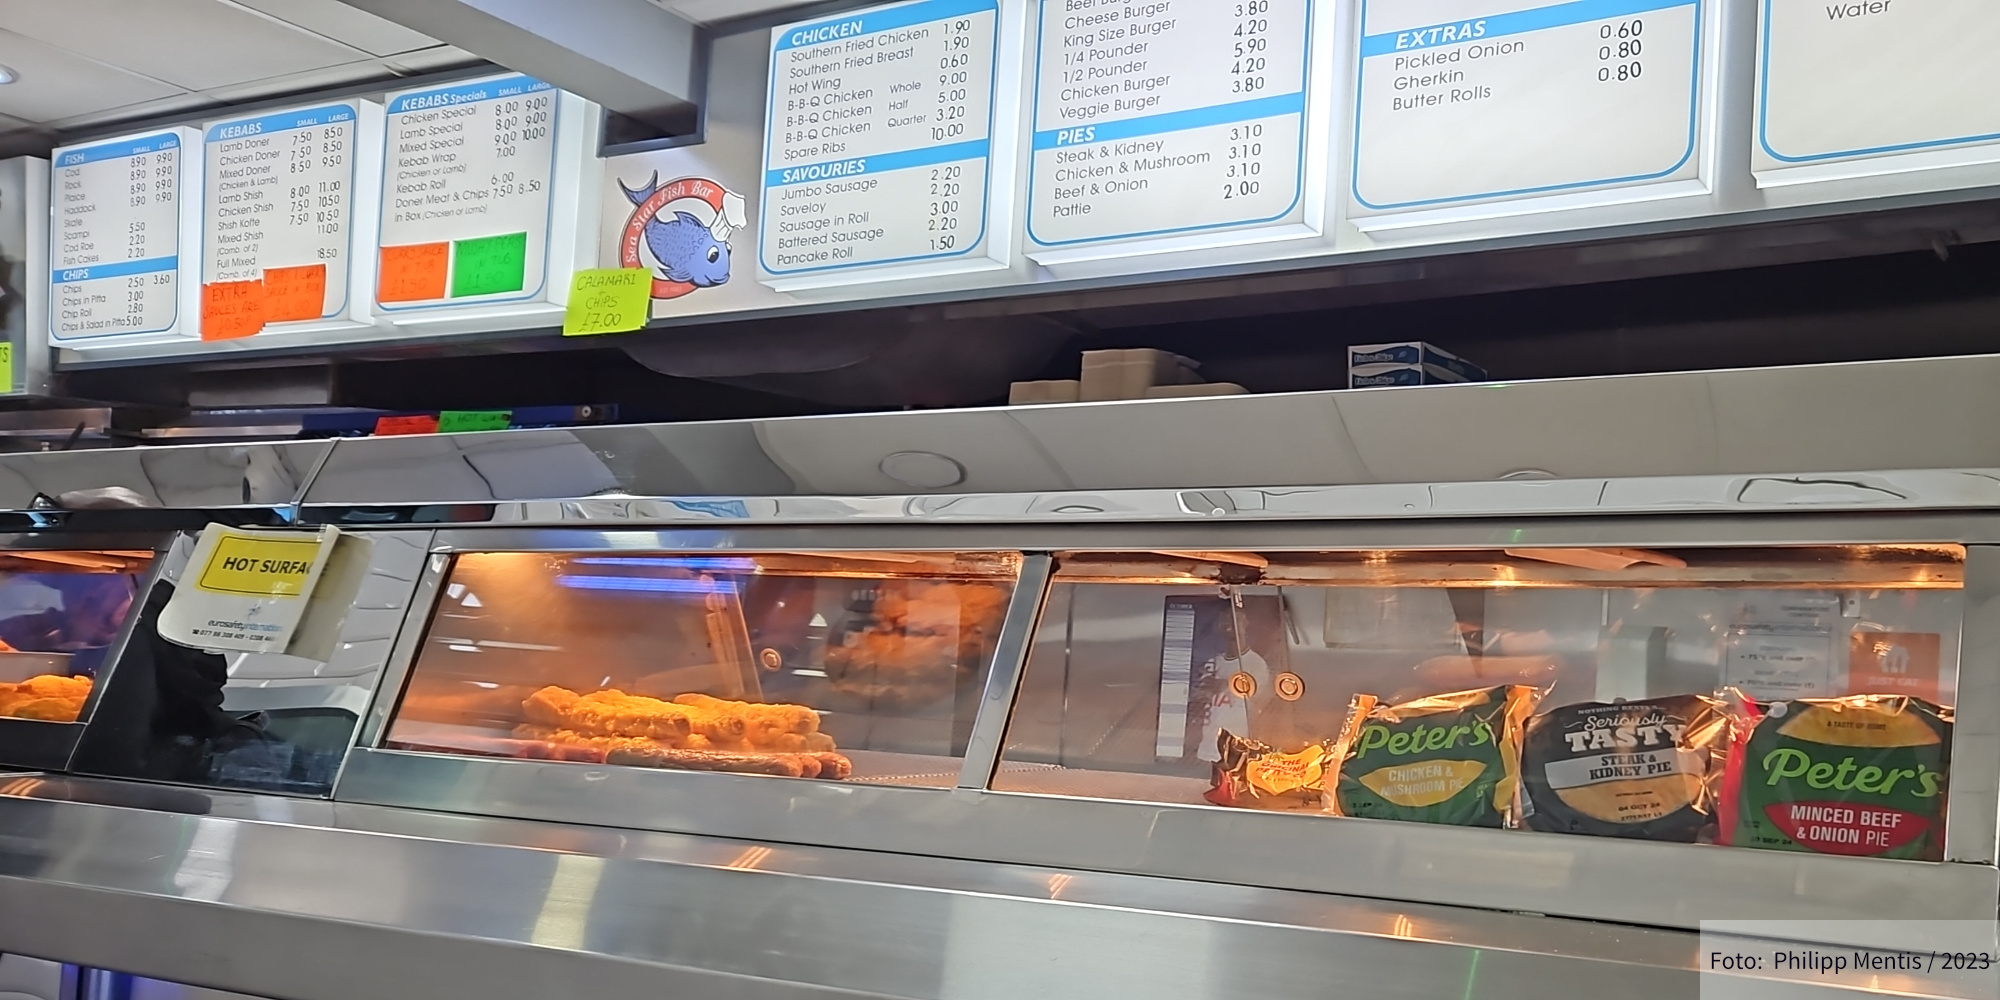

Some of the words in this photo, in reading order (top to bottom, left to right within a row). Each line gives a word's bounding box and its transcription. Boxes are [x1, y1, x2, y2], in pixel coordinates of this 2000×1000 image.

[1065, 11, 1119, 29] Cheese
[1124, 2, 1170, 18] Burger
[1825, 0, 1891, 20] Water
[791, 20, 863, 46] CHICKEN
[1064, 34, 1094, 47] King
[1099, 28, 1125, 42] Size
[1130, 18, 1177, 35] Burger
[1234, 0, 1268, 18] 3.80
[1395, 20, 1486, 50] EXTRAS
[790, 43, 842, 62] Southern
[845, 37, 874, 53] Fried
[878, 27, 929, 47] Chicken
[944, 19, 971, 34] 1.90
[1064, 51, 1084, 66] 1/4
[1089, 42, 1149, 62] Pounder
[1233, 19, 1268, 37] 4.20
[1394, 48, 1460, 71] Pickled
[1468, 40, 1524, 60] Onion
[1600, 20, 1642, 39] 0.60
[789, 81, 808, 95] Hot
[811, 77, 841, 91] Wing
[940, 54, 968, 69] 0.60
[1393, 70, 1464, 91] Gherkin
[1598, 40, 1642, 60] 0.80
[498, 87, 522, 96] SMALL
[788, 96, 821, 111] B-B-Q
[823, 88, 873, 105] Chicken
[889, 81, 921, 94] Whole
[939, 71, 967, 86] 9.00
[1061, 84, 1119, 102] Chicken
[1124, 74, 1170, 92] Burger
[1231, 57, 1265, 75] 4.20
[1393, 92, 1444, 110] Butter
[1450, 86, 1492, 103] Rolls
[1597, 62, 1642, 82] 0.80
[401, 93, 449, 111] KEBABS
[450, 90, 487, 104] Specials
[1059, 102, 1110, 119] Veggie
[1114, 94, 1161, 111] Burger
[1232, 76, 1265, 93] 3.80
[297, 118, 317, 127] SMALL
[328, 113, 349, 122] LARGE
[401, 112, 439, 125] Chicken
[442, 106, 476, 119] Special
[495, 101, 518, 116] 8.00
[785, 129, 818, 143] B-B-Q
[821, 122, 871, 139] Chicken
[887, 114, 926, 128] Quarter
[936, 105, 965, 122] 3.20
[220, 123, 262, 138] KEBABS
[784, 145, 818, 160] Spare
[822, 141, 846, 154] Ribs
[931, 123, 964, 141] 10.00
[1057, 127, 1095, 145] PIES
[133, 146, 150, 154] SMALL
[159, 140, 177, 149] LARGE
[1056, 151, 1095, 164] Steak
[1100, 146, 1110, 158] &
[1114, 140, 1164, 157] Kidney
[1230, 124, 1262, 141] 3.10
[65, 153, 85, 164] FISH
[220, 154, 253, 166] Chicken
[256, 150, 280, 161] Doner
[398, 155, 429, 168] Kebab
[432, 153, 456, 164] Wrap
[1055, 164, 1114, 182] Chicken
[1118, 161, 1129, 173] &
[1134, 152, 1211, 172] Mushroom
[1228, 143, 1261, 160] 3.10
[781, 186, 822, 200] Jumbo
[825, 179, 878, 195] Sausage
[931, 166, 961, 181] 2.20
[782, 159, 866, 184] SAVOURIES
[1054, 185, 1086, 200] Beef
[1090, 184, 1100, 195] &
[1104, 178, 1148, 194] Onion
[1226, 162, 1261, 178] 3.10
[219, 193, 241, 204] Lamb
[244, 190, 263, 200] Shish
[290, 185, 310, 198] 8.00
[319, 181, 341, 193] 11.00
[396, 198, 423, 208] Doner
[426, 194, 450, 205] Meat
[453, 192, 460, 201] &
[462, 189, 489, 200] Chips
[518, 180, 541, 195] 8.50
[780, 201, 826, 216] Saveloy
[931, 183, 960, 197] 2.20
[1053, 204, 1091, 218] Pattie
[1223, 180, 1260, 200] 2.00
[626, 237, 636, 262] Sea
[633, 202, 655, 230] Star
[658, 182, 685, 205] Fish
[691, 181, 714, 197] Bar
[779, 217, 830, 233] Sausage
[833, 215, 844, 225] in
[848, 211, 869, 224] Roll
[930, 200, 959, 216] 3.00
[64, 244, 78, 253] Cod
[64, 257, 75, 265] Fish
[78, 254, 99, 264] Cakes
[777, 251, 829, 265] Pancake
[832, 247, 853, 259] Roll
[930, 235, 955, 250] 1.50
[62, 268, 89, 281] CHIPS
[217, 259, 229, 268] Full
[232, 257, 255, 266] Mixed
[577, 273, 636, 290] CALAMARI
[62, 310, 78, 319] Chip
[81, 308, 92, 317] Roll
[586, 296, 620, 310] CHIPS
[222, 557, 260, 571] HOT
[1866, 677, 1894, 686] JUST
[1578, 706, 1619, 714] NOTHING
[1584, 713, 1667, 731] Seriously
[1357, 720, 1489, 759] Peter's
[1565, 724, 1687, 752] TASTY
[1590, 767, 1641, 780] KIDNEY
[1647, 761, 1671, 774] PIE
[1601, 754, 1646, 766] STEAK
[1388, 764, 1442, 782] CHICKEN
[1445, 767, 1453, 777] &
[1762, 748, 1943, 798] Peter's
[1381, 780, 1445, 796] MUSHROOM
[1450, 778, 1464, 790] PIE
[1791, 805, 1854, 824] MINCED
[1860, 811, 1902, 828] BEEF
[1796, 827, 1806, 839] &
[1809, 826, 1860, 843] ONION
[1866, 831, 1890, 847] PIE
